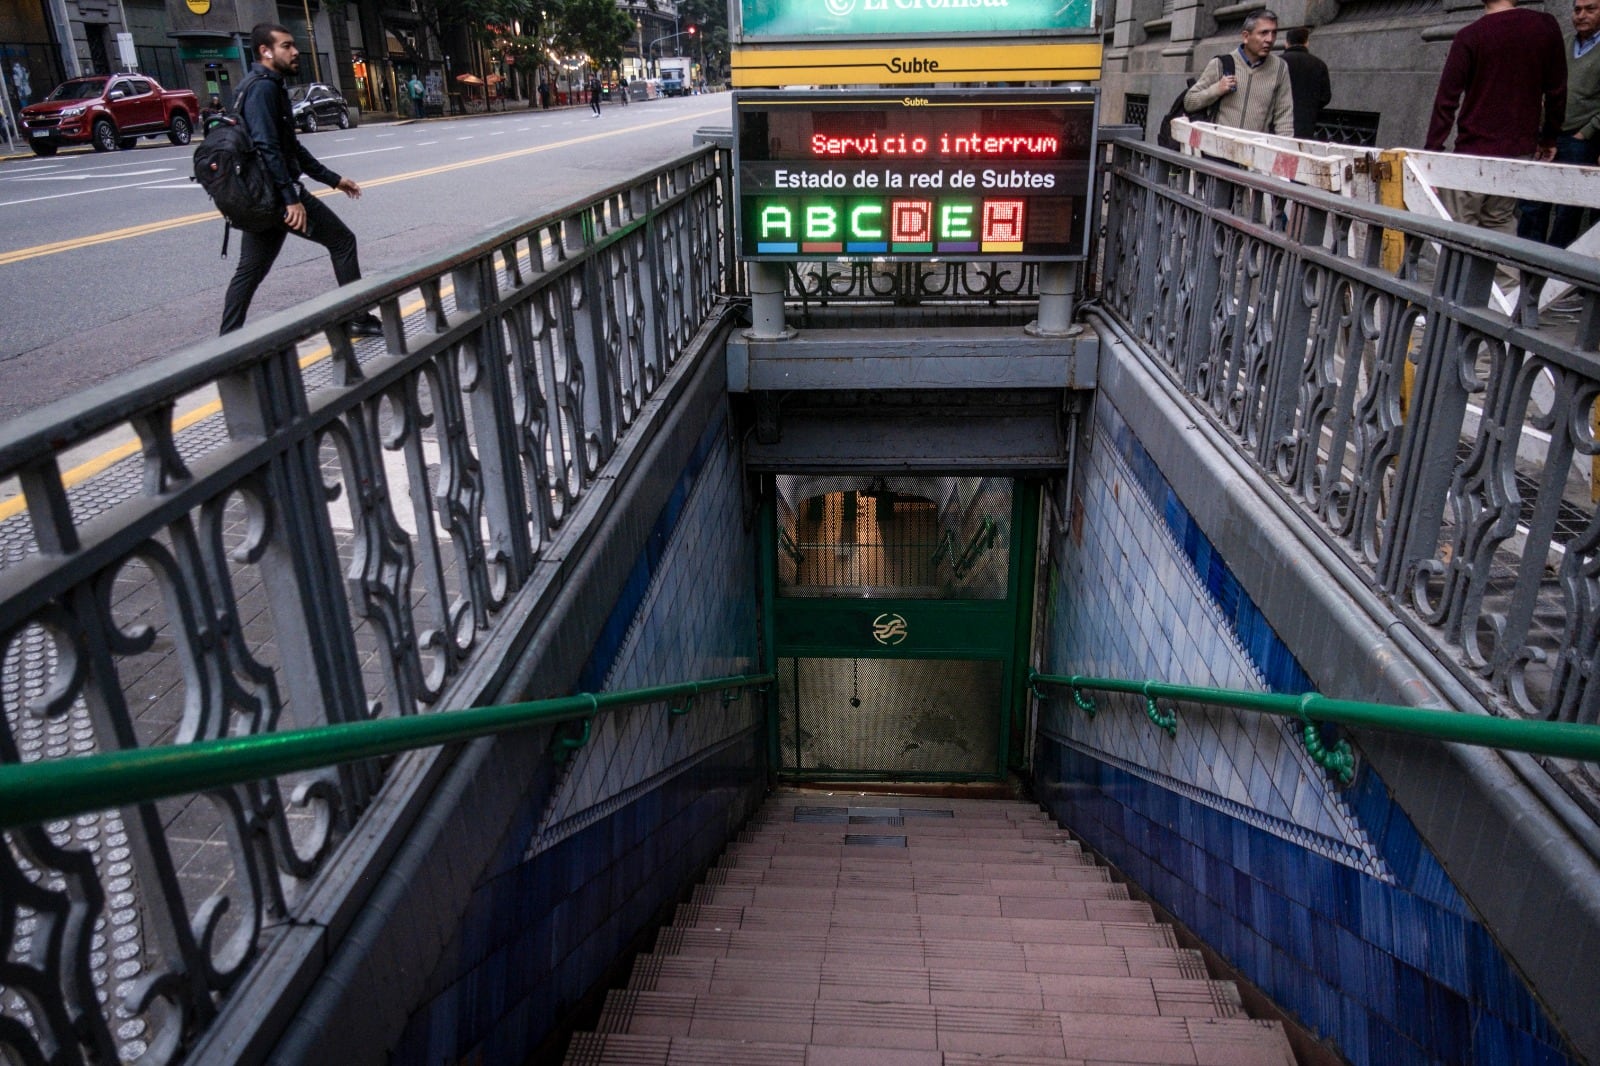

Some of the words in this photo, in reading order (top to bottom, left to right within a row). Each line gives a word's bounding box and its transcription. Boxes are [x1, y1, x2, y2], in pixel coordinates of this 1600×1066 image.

[891, 57, 939, 73] Subte
[903, 97, 929, 106] Subte
[812, 133, 927, 154] Servicio
[940, 132, 1057, 153] interrum
[775, 169, 847, 188] Estado
[852, 169, 879, 188] de
[885, 169, 903, 188] la
[909, 169, 943, 188] red
[949, 169, 976, 188] de
[981, 169, 1056, 188] Subtes
[762, 206, 791, 238] A
[807, 206, 837, 238] B
[852, 206, 882, 238] C
[897, 206, 929, 237] D
[942, 206, 973, 238] E
[987, 206, 1018, 237] H
